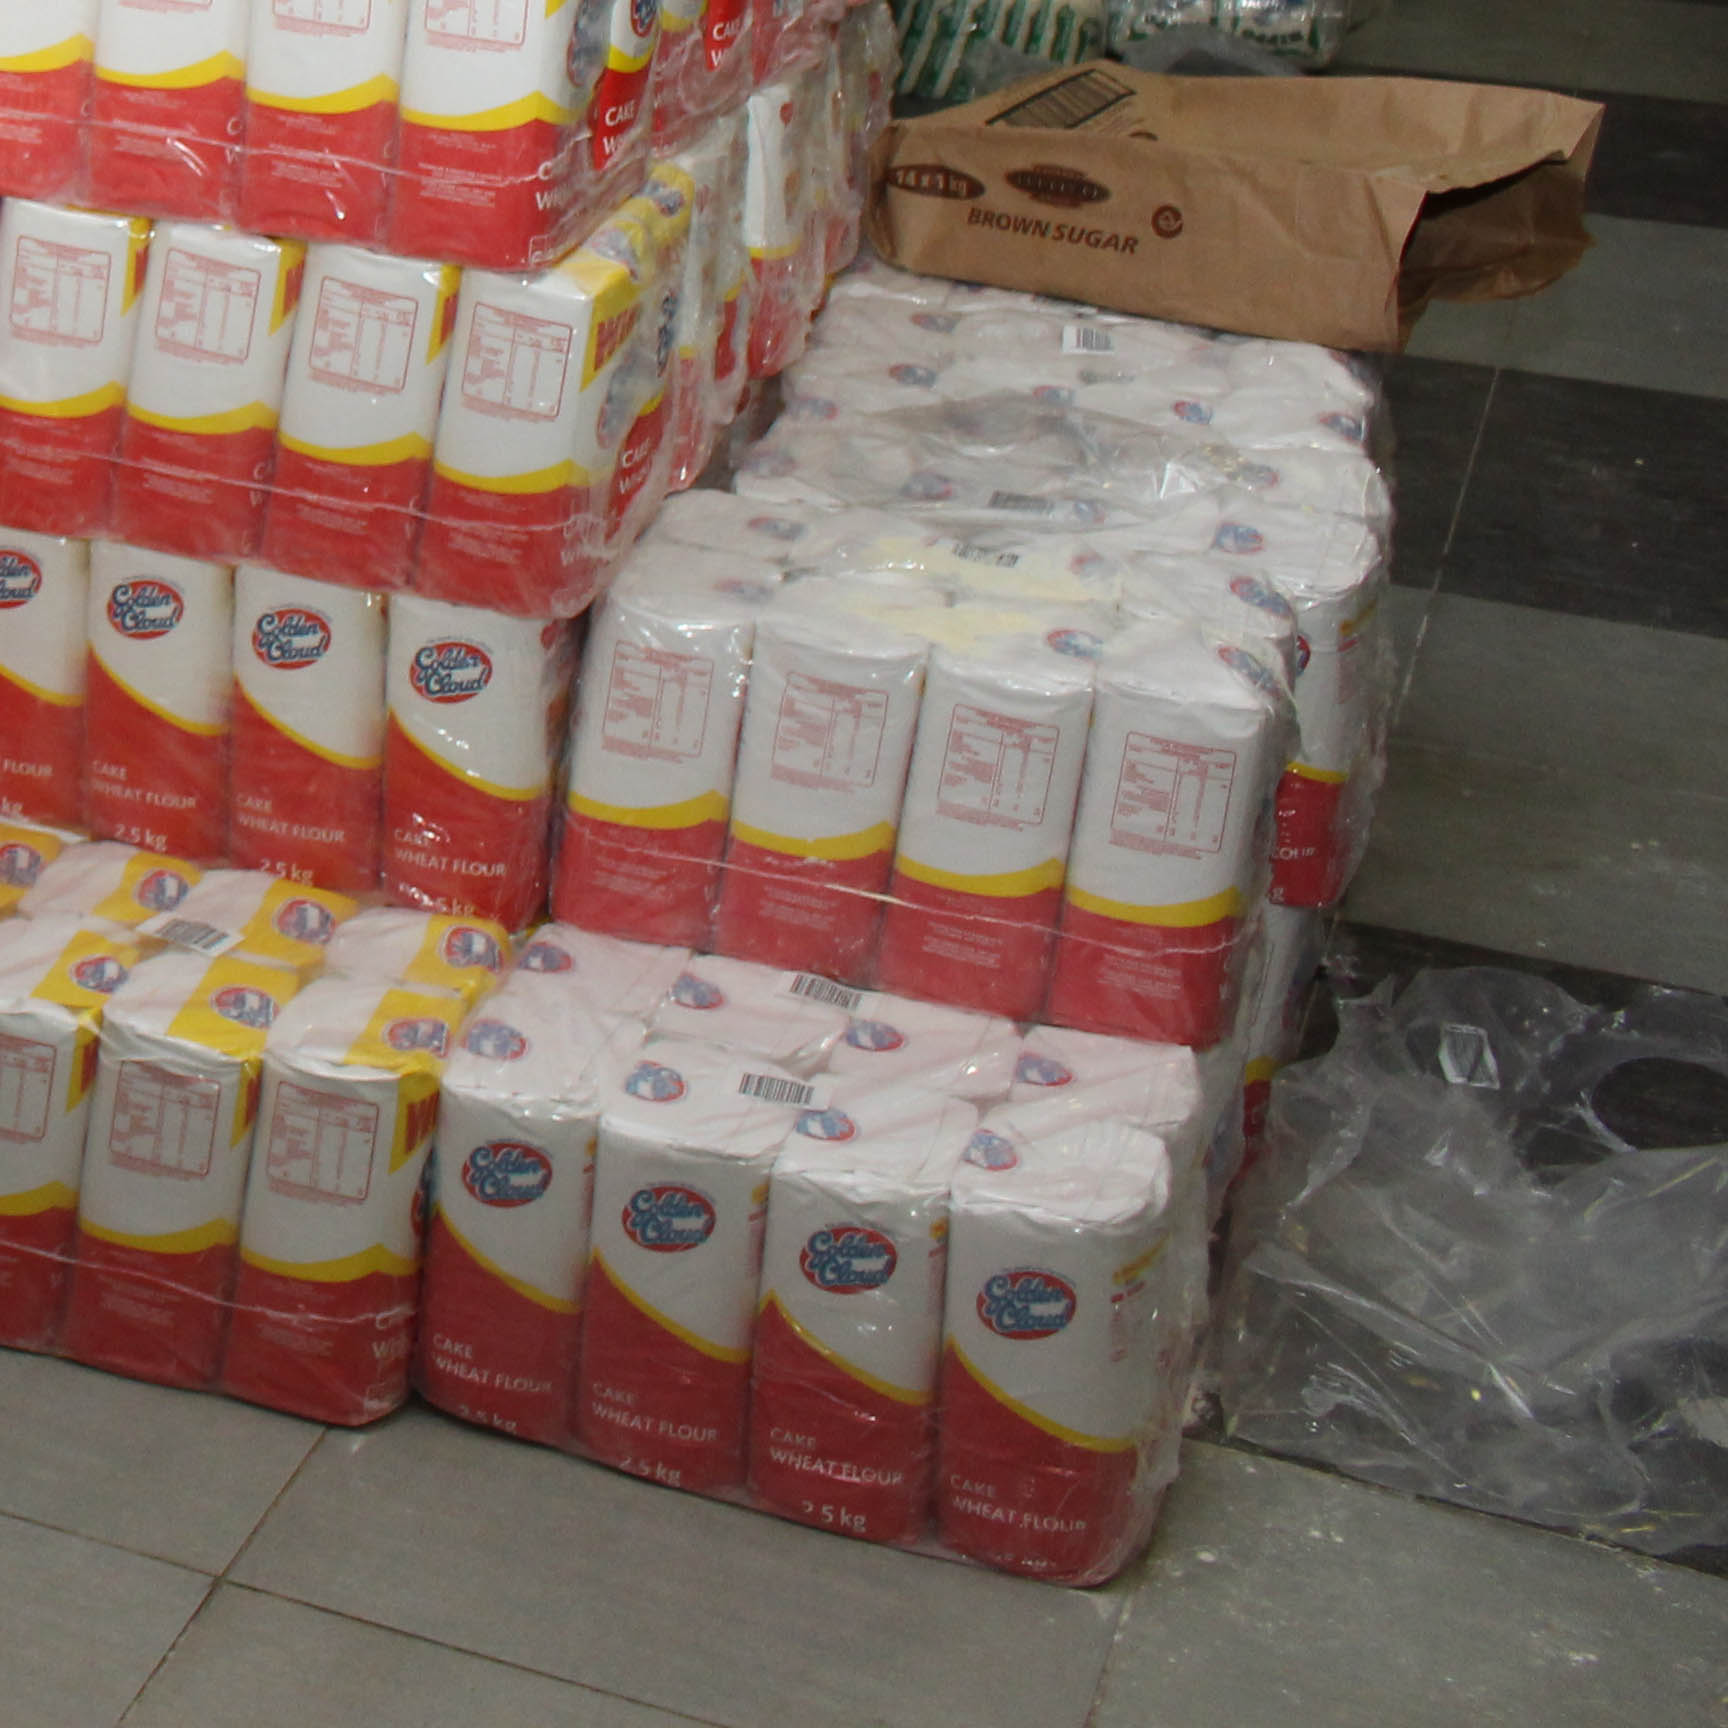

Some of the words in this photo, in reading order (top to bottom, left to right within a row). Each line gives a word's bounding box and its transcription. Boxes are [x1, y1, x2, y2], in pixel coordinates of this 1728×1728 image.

[967, 206, 1052, 238] BROWN
[1052, 223, 1140, 256] SUGAR
[112, 585, 175, 629] Golden
[125, 605, 180, 634] Cloud
[256, 613, 323, 658] Golden
[267, 635, 328, 663] Cloud
[413, 646, 480, 691] Golden
[425, 668, 488, 696] Cloud
[3, 758, 54, 778] FLOUR
[144, 792, 197, 812] FLOUR
[146, 831, 168, 853] kg
[291, 823, 346, 844] FLOUR
[469, 1146, 543, 1197] Golden
[481, 1170, 546, 1204] Cloud
[629, 1190, 707, 1243] Golden
[806, 1232, 888, 1281] Golden
[819, 1258, 892, 1288] Cloud
[983, 1278, 1068, 1329] Golden
[433, 1333, 473, 1360] CAKE
[592, 1404, 655, 1436] WHEAT
[658, 1419, 719, 1443] FLOUR
[656, 1463, 684, 1488] kg
[838, 1508, 868, 1534] kg
[951, 1493, 1018, 1527] WHEAT
